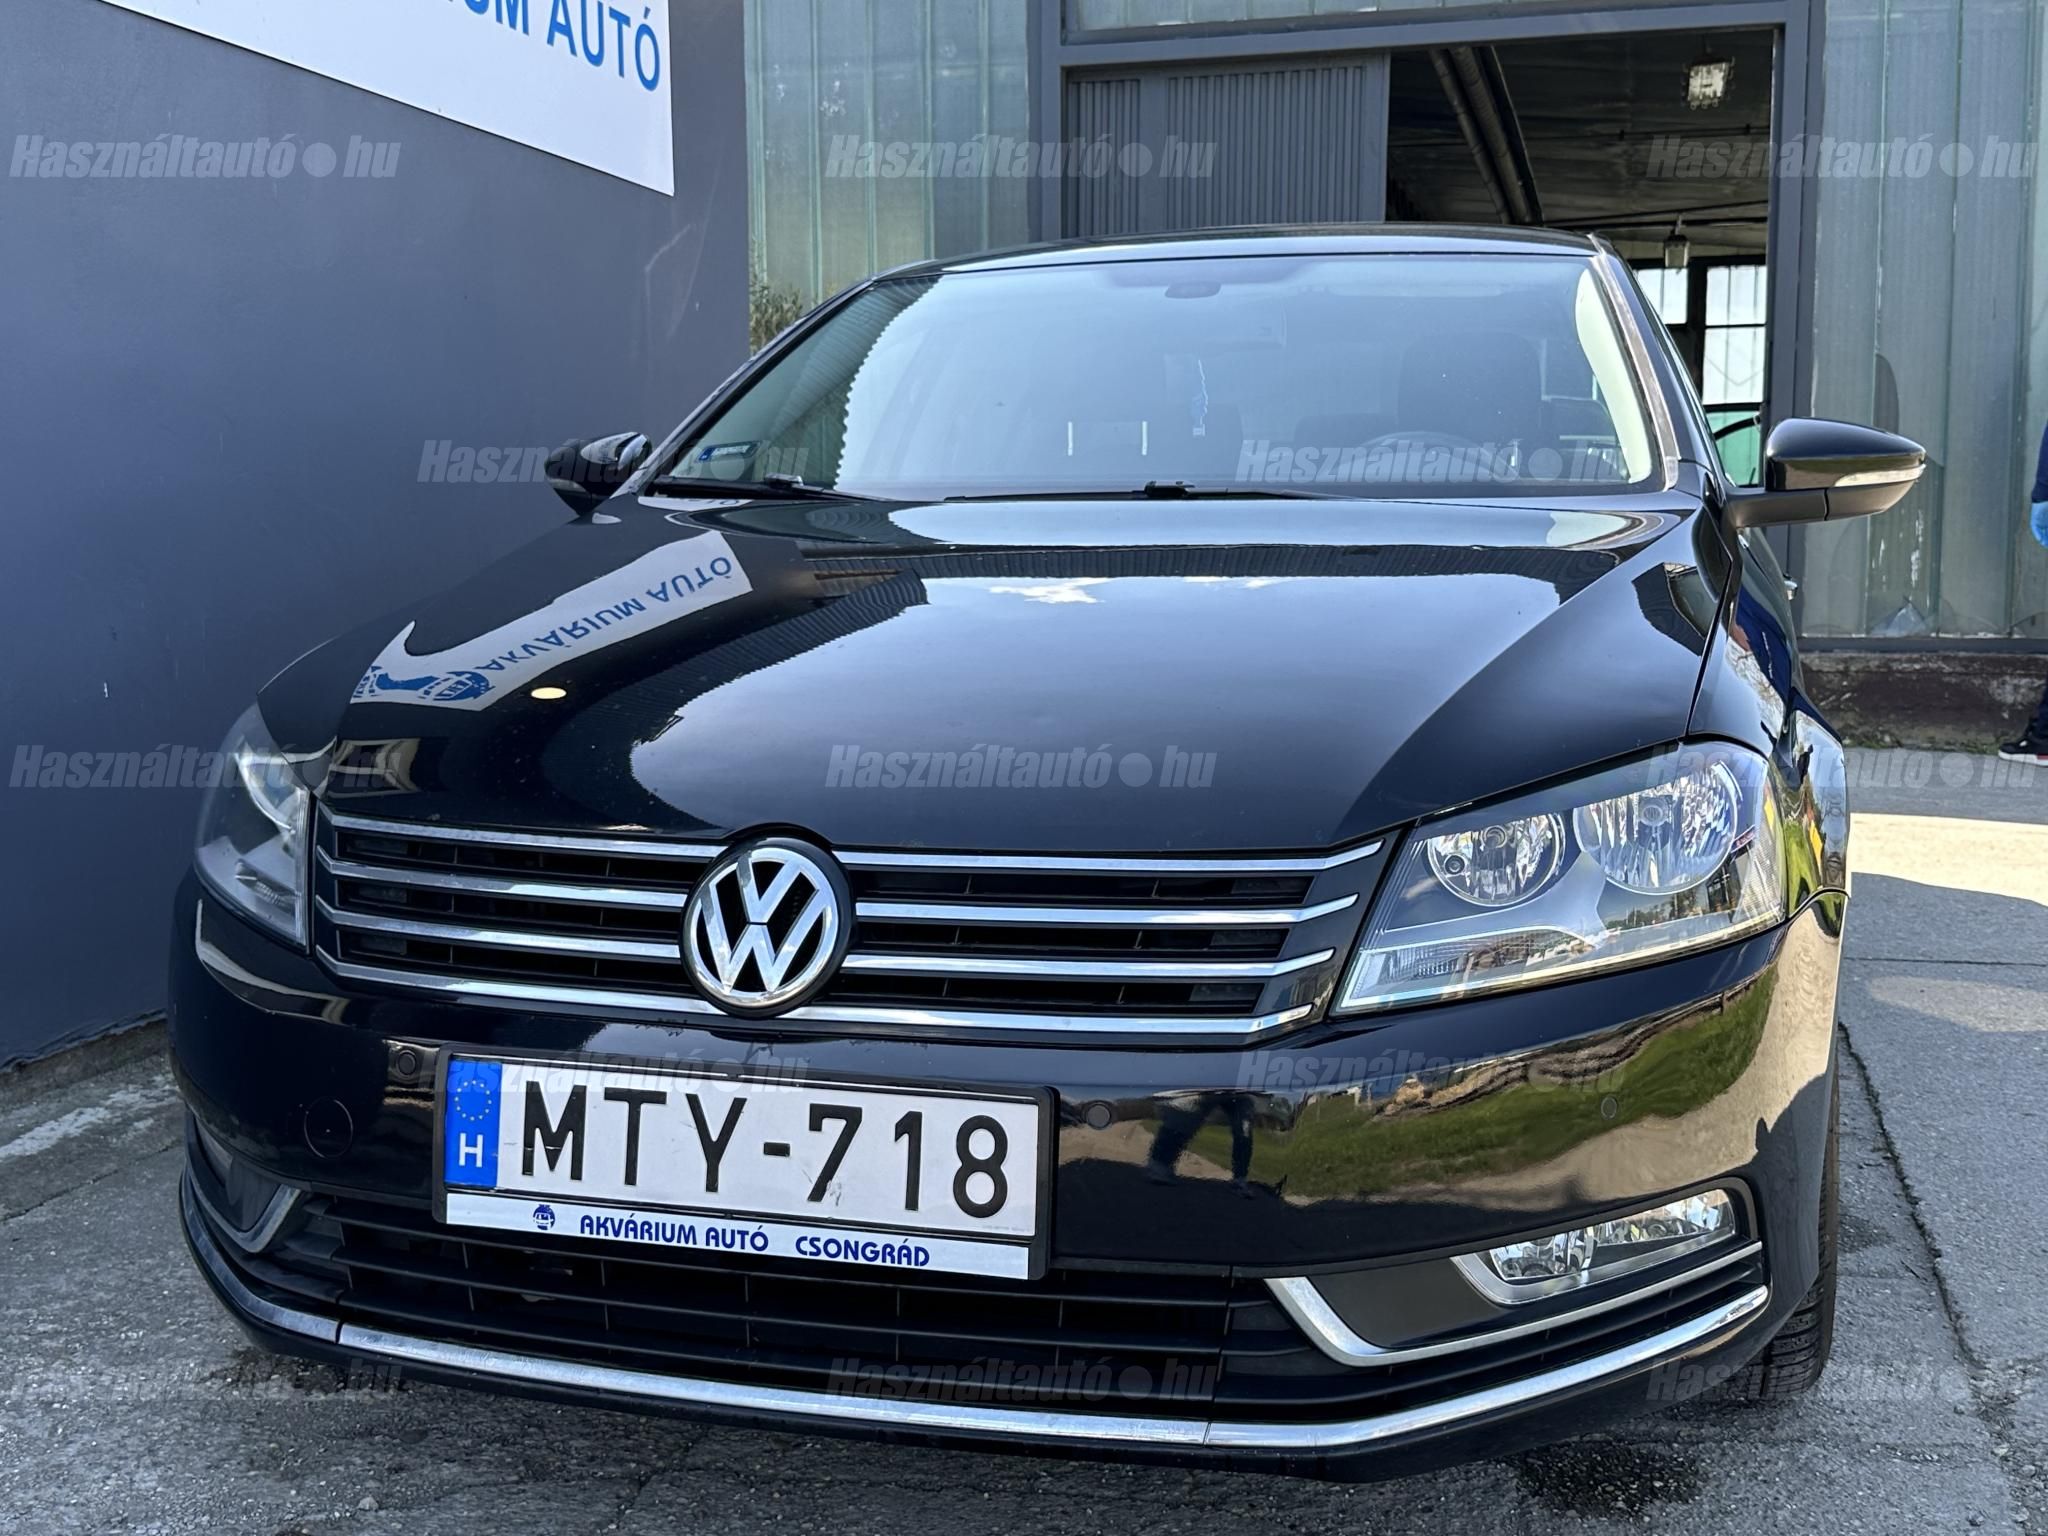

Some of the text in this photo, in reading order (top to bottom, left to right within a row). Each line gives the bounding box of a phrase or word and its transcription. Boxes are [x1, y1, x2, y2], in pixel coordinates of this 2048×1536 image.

[547, 0, 660, 91] AUTÓ
[459, 1133, 483, 1168] H
[522, 1081, 1008, 1219] MTY-718
[579, 1213, 930, 1267] AKVÁRIUM AUTÓ CSONGRÁD
